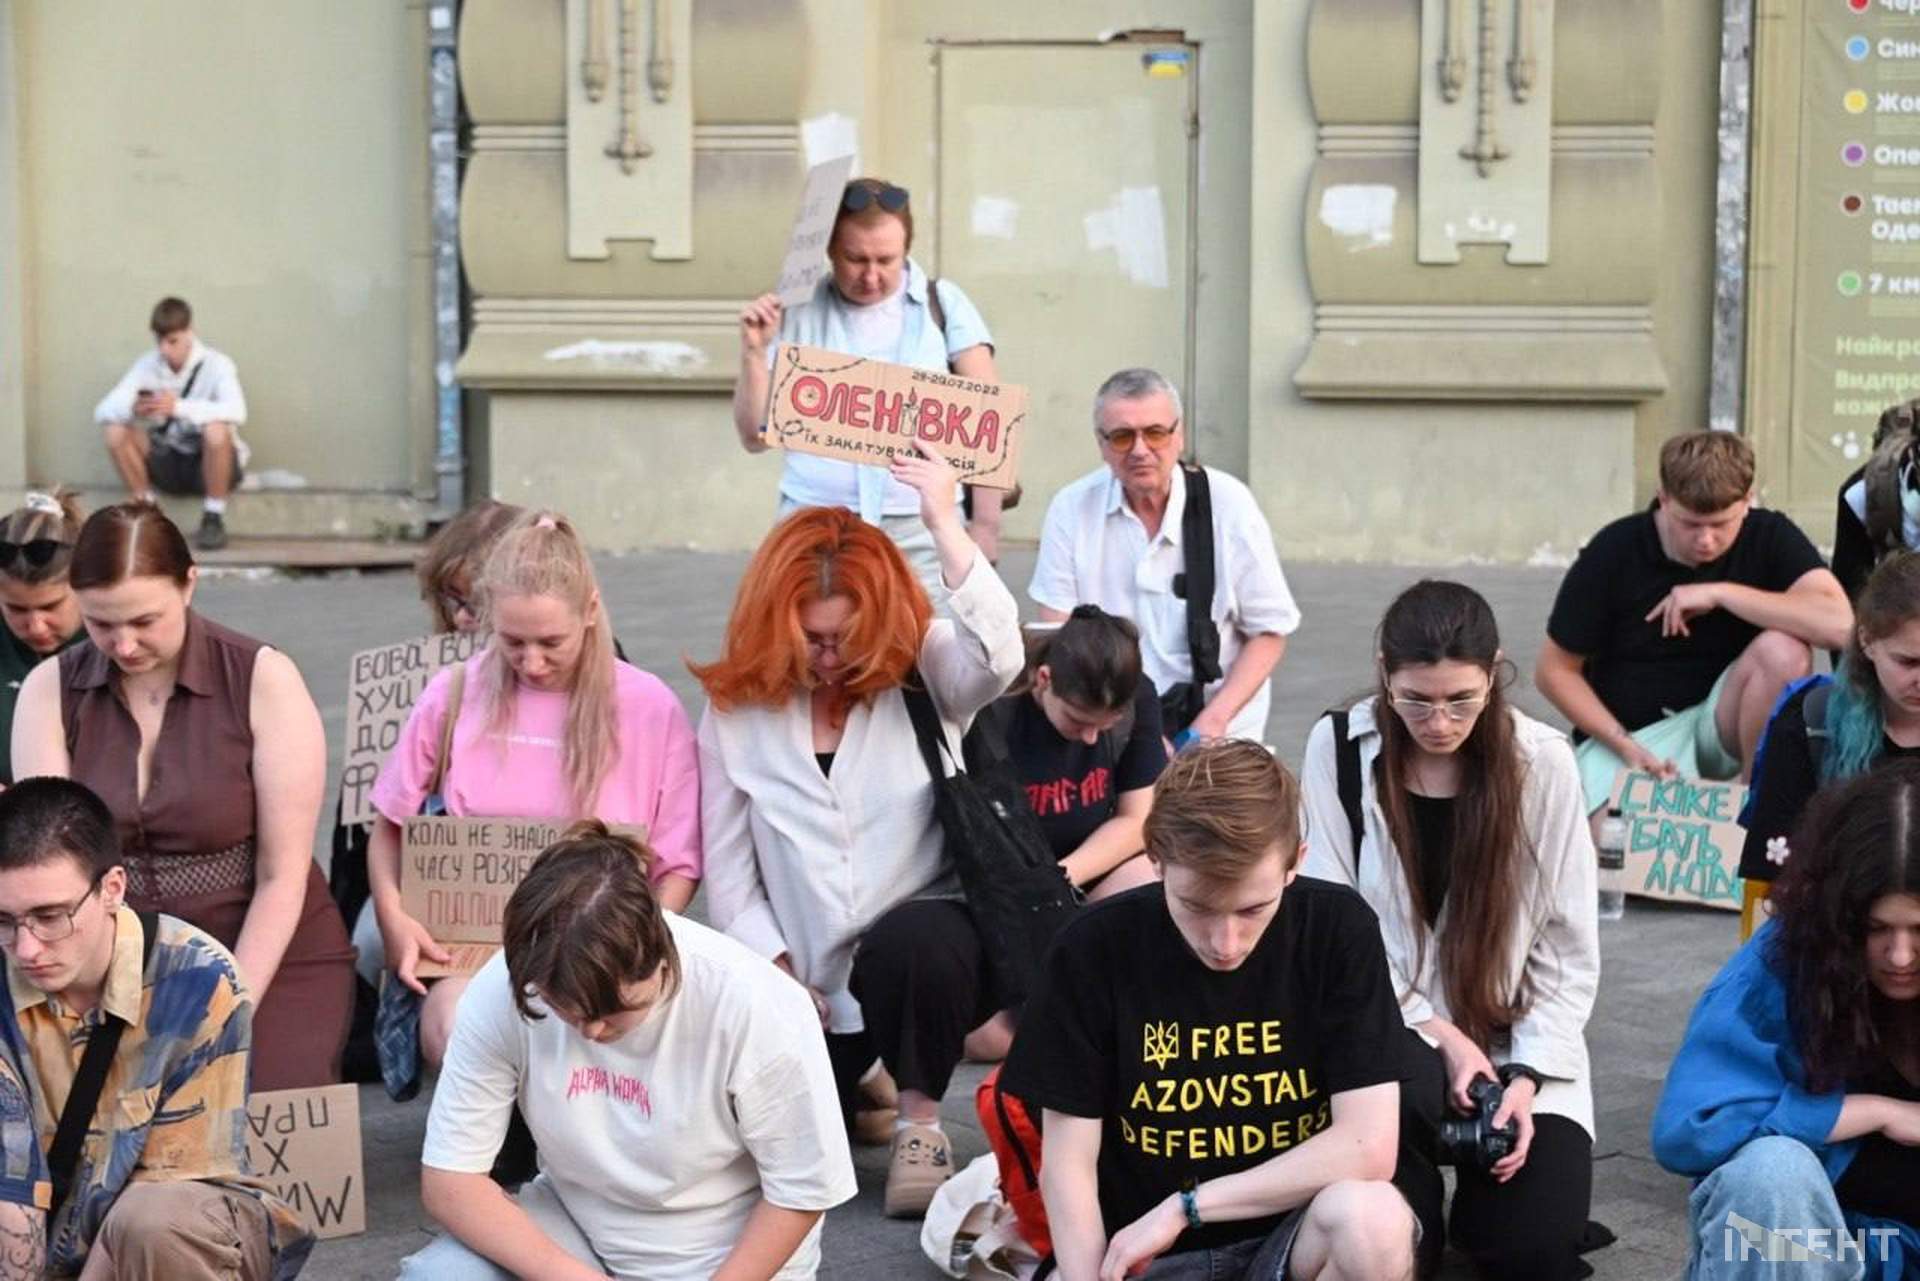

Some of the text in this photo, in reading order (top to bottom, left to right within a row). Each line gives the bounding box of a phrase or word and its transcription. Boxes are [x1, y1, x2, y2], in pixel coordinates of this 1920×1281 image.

[1869, 272, 1883, 294] 7
[407, 821, 457, 846] КОЛИ
[468, 823, 492, 846] НЕ
[414, 852, 536, 884] ЧАСУ РОЗІБ
[1191, 1020, 1282, 1061] FREE
[1130, 1068, 1317, 1113] AZOVSTAL
